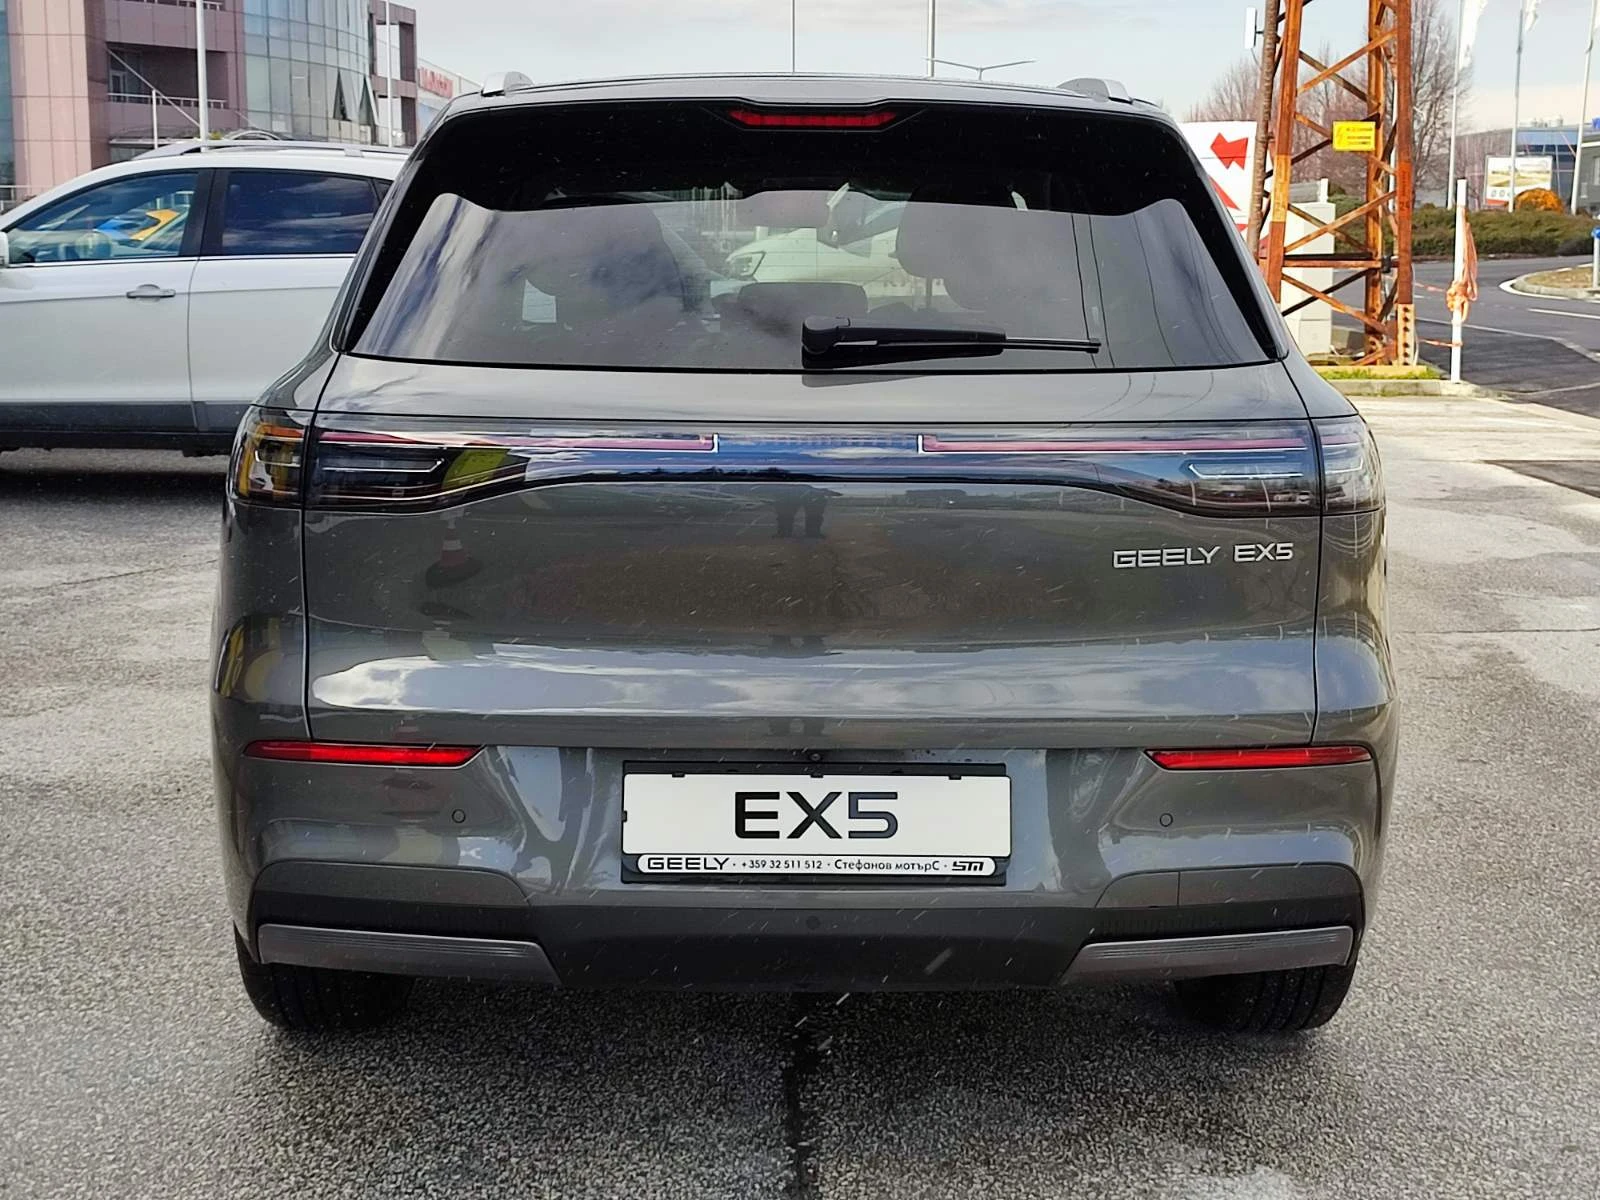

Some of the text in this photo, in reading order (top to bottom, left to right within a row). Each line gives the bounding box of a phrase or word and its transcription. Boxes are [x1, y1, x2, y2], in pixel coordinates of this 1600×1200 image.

[1112, 541, 1294, 569] GEELY EX5
[734, 791, 899, 839] EX5
[647, 856, 730, 871] GEELY
[741, 859, 767, 869] +359
[769, 859, 782, 870] 32
[784, 860, 802, 870] 511
[804, 860, 823, 870] 512
[834, 859, 893, 872] Стефанов
